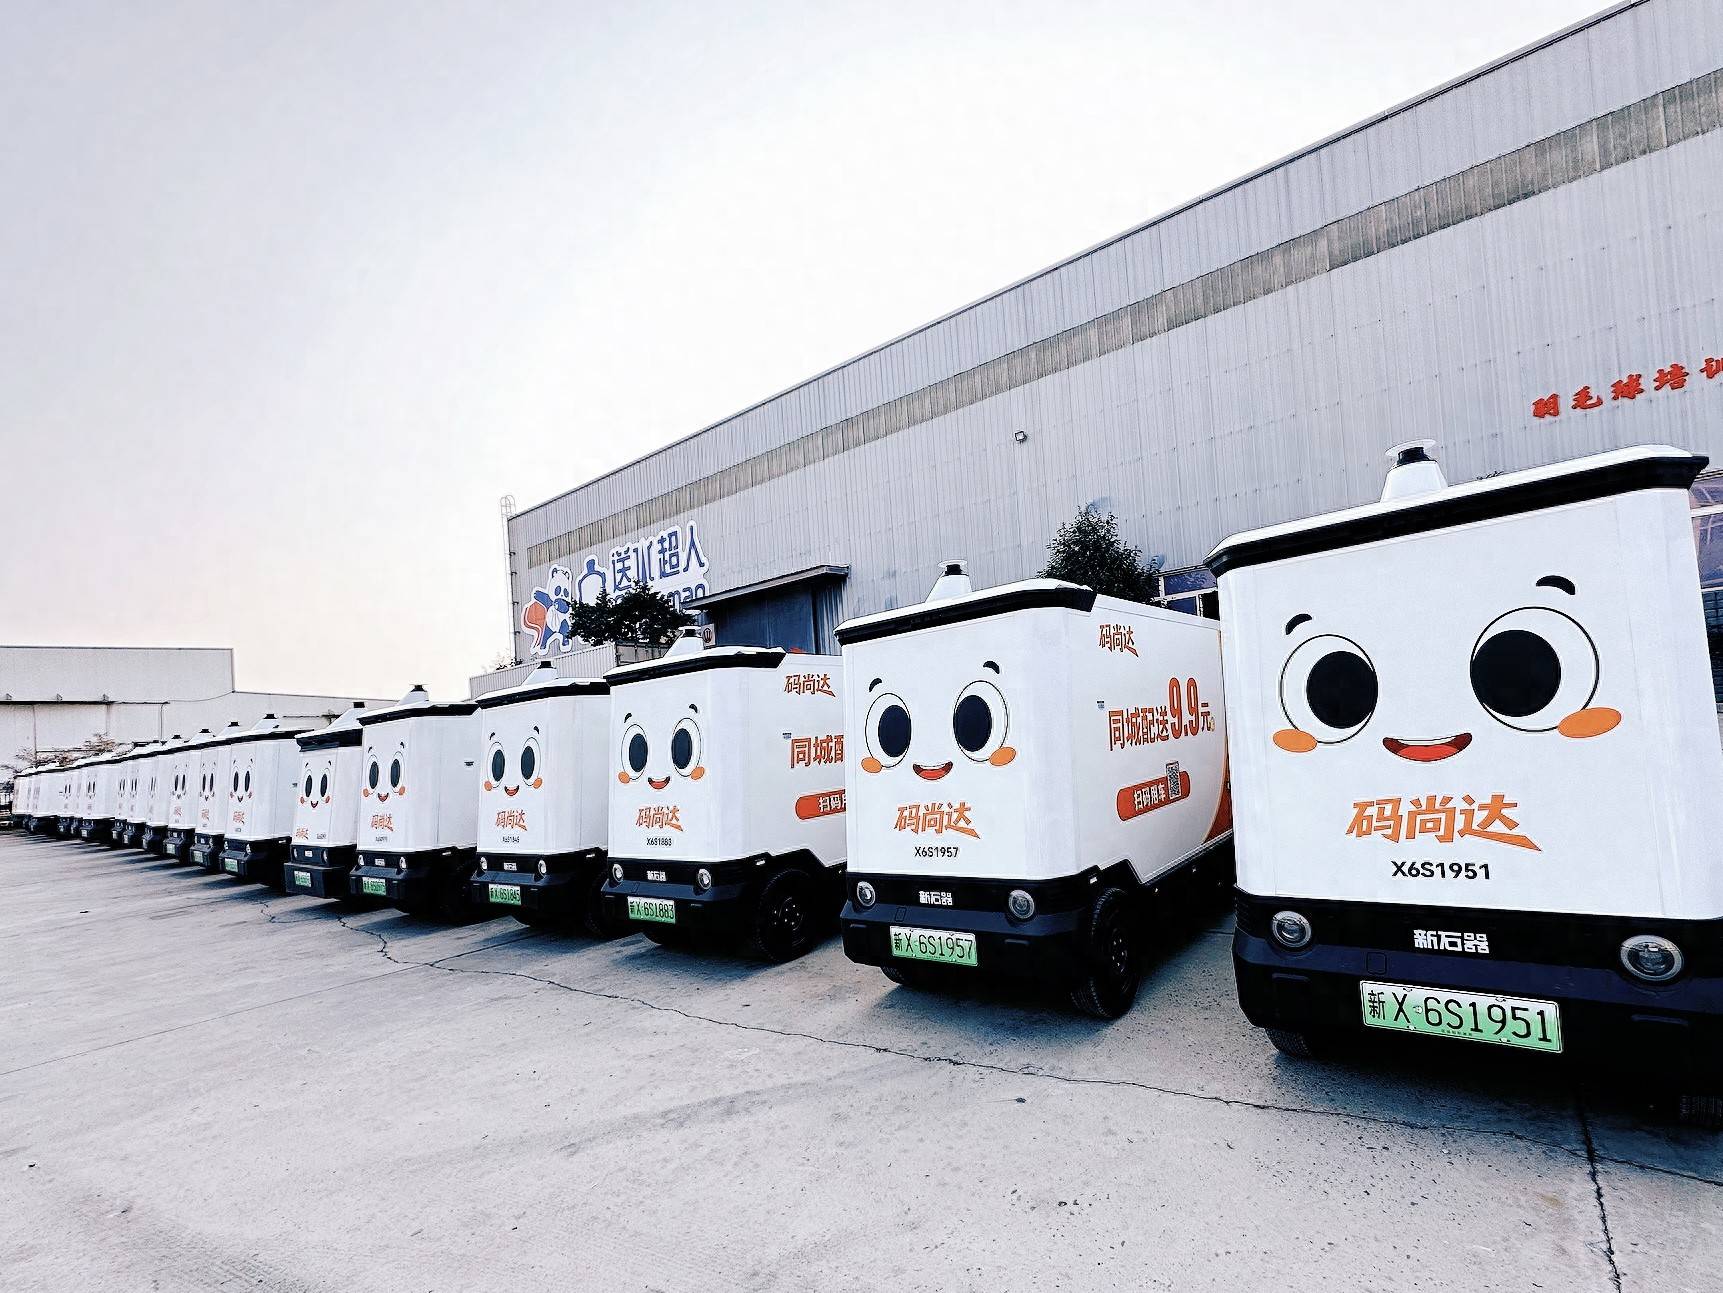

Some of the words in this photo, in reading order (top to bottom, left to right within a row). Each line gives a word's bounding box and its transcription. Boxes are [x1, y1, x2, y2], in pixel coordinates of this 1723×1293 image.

[611, 525, 705, 593] 送水超人
[1099, 624, 1138, 657] 码尚达
[784, 673, 836, 697] 码尚达
[1133, 783, 1166, 810] 扫码用车
[635, 805, 684, 832] 码尚达
[893, 801, 981, 840] 码尚达
[1346, 793, 1542, 852] 码尚达
[914, 847, 959, 858] X6S1957
[1391, 861, 1491, 880] X6S1951
[919, 890, 953, 906] 新石器
[1413, 930, 1490, 954] 新石器
